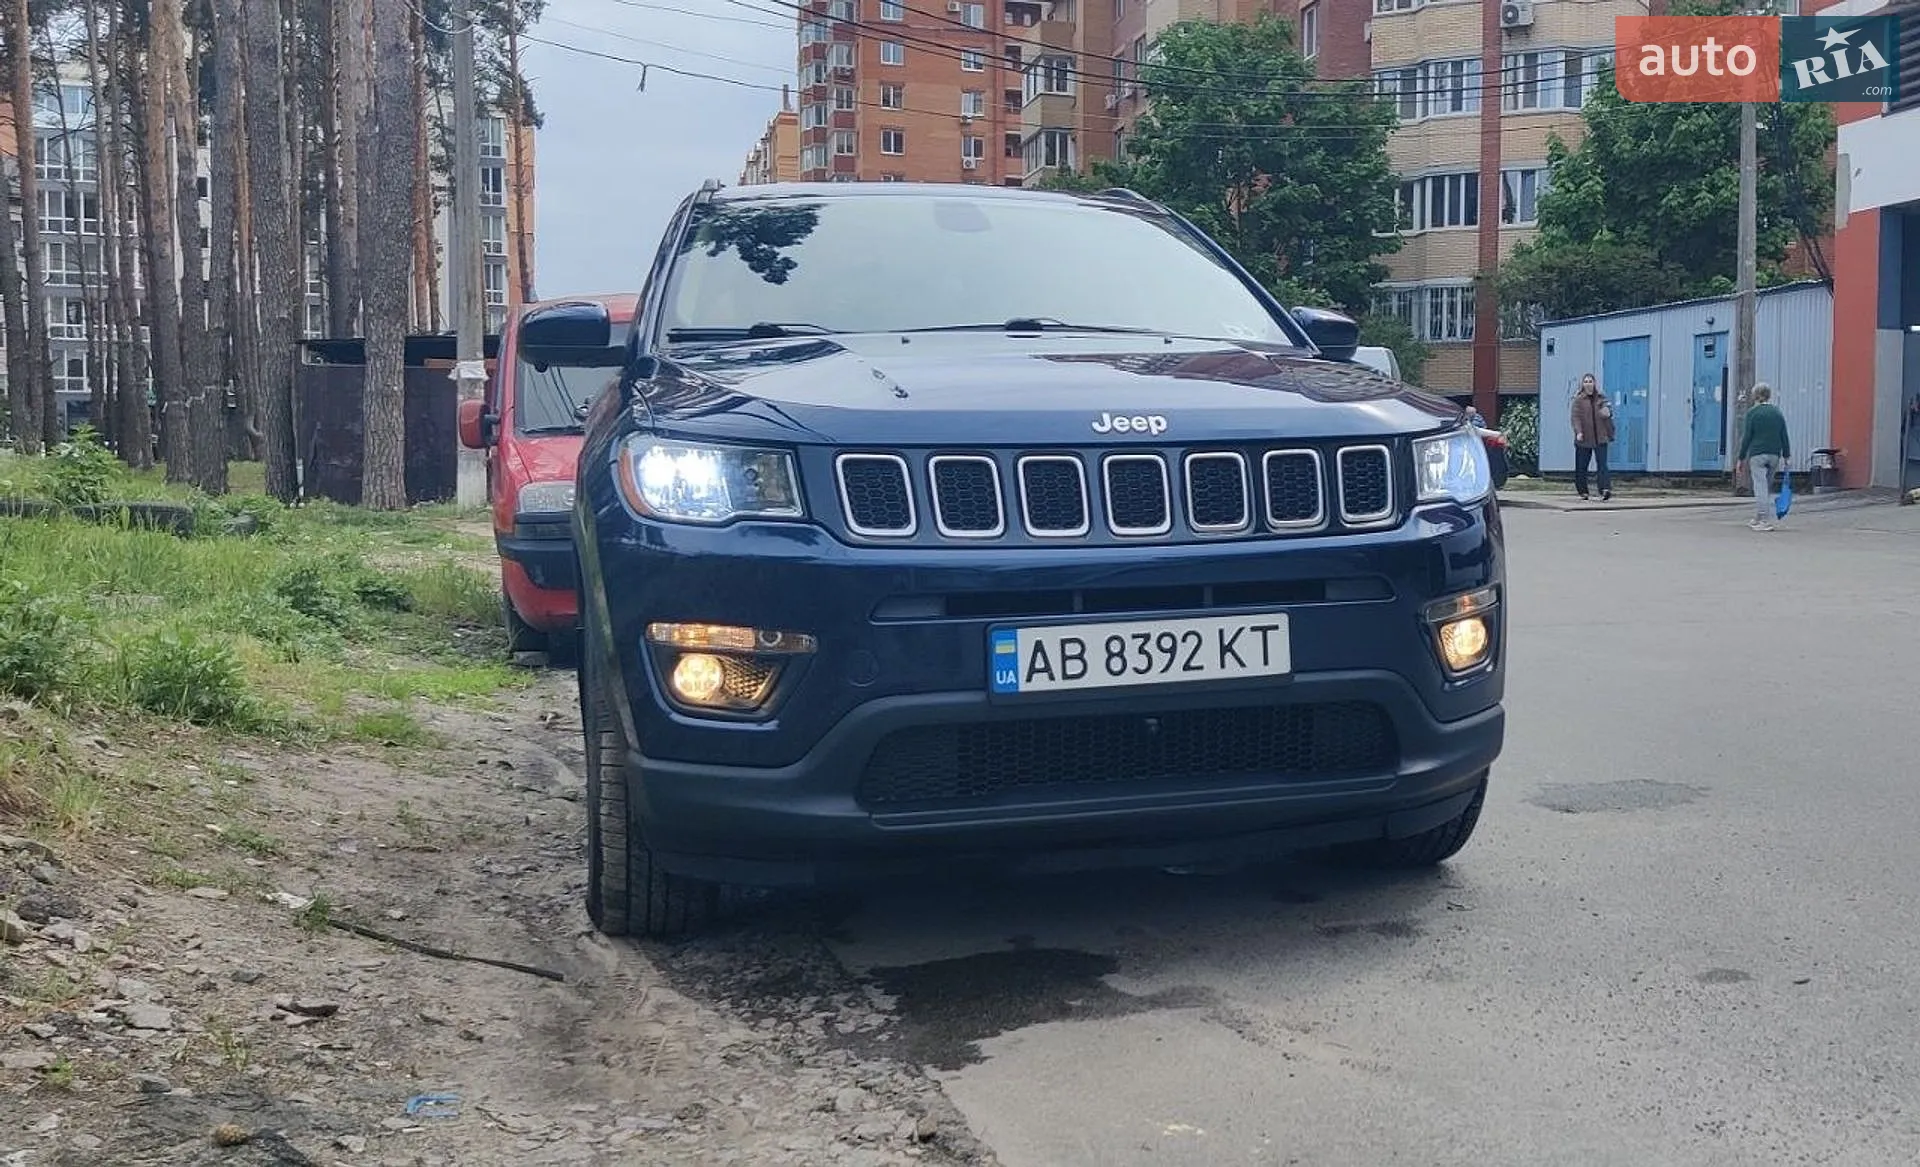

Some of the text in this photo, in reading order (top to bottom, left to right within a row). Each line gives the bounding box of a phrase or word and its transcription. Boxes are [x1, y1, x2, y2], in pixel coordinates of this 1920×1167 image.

[1091, 411, 1168, 436] Jeep
[1025, 624, 1280, 683] AB 8392 KT
[995, 669, 1017, 685] UA
